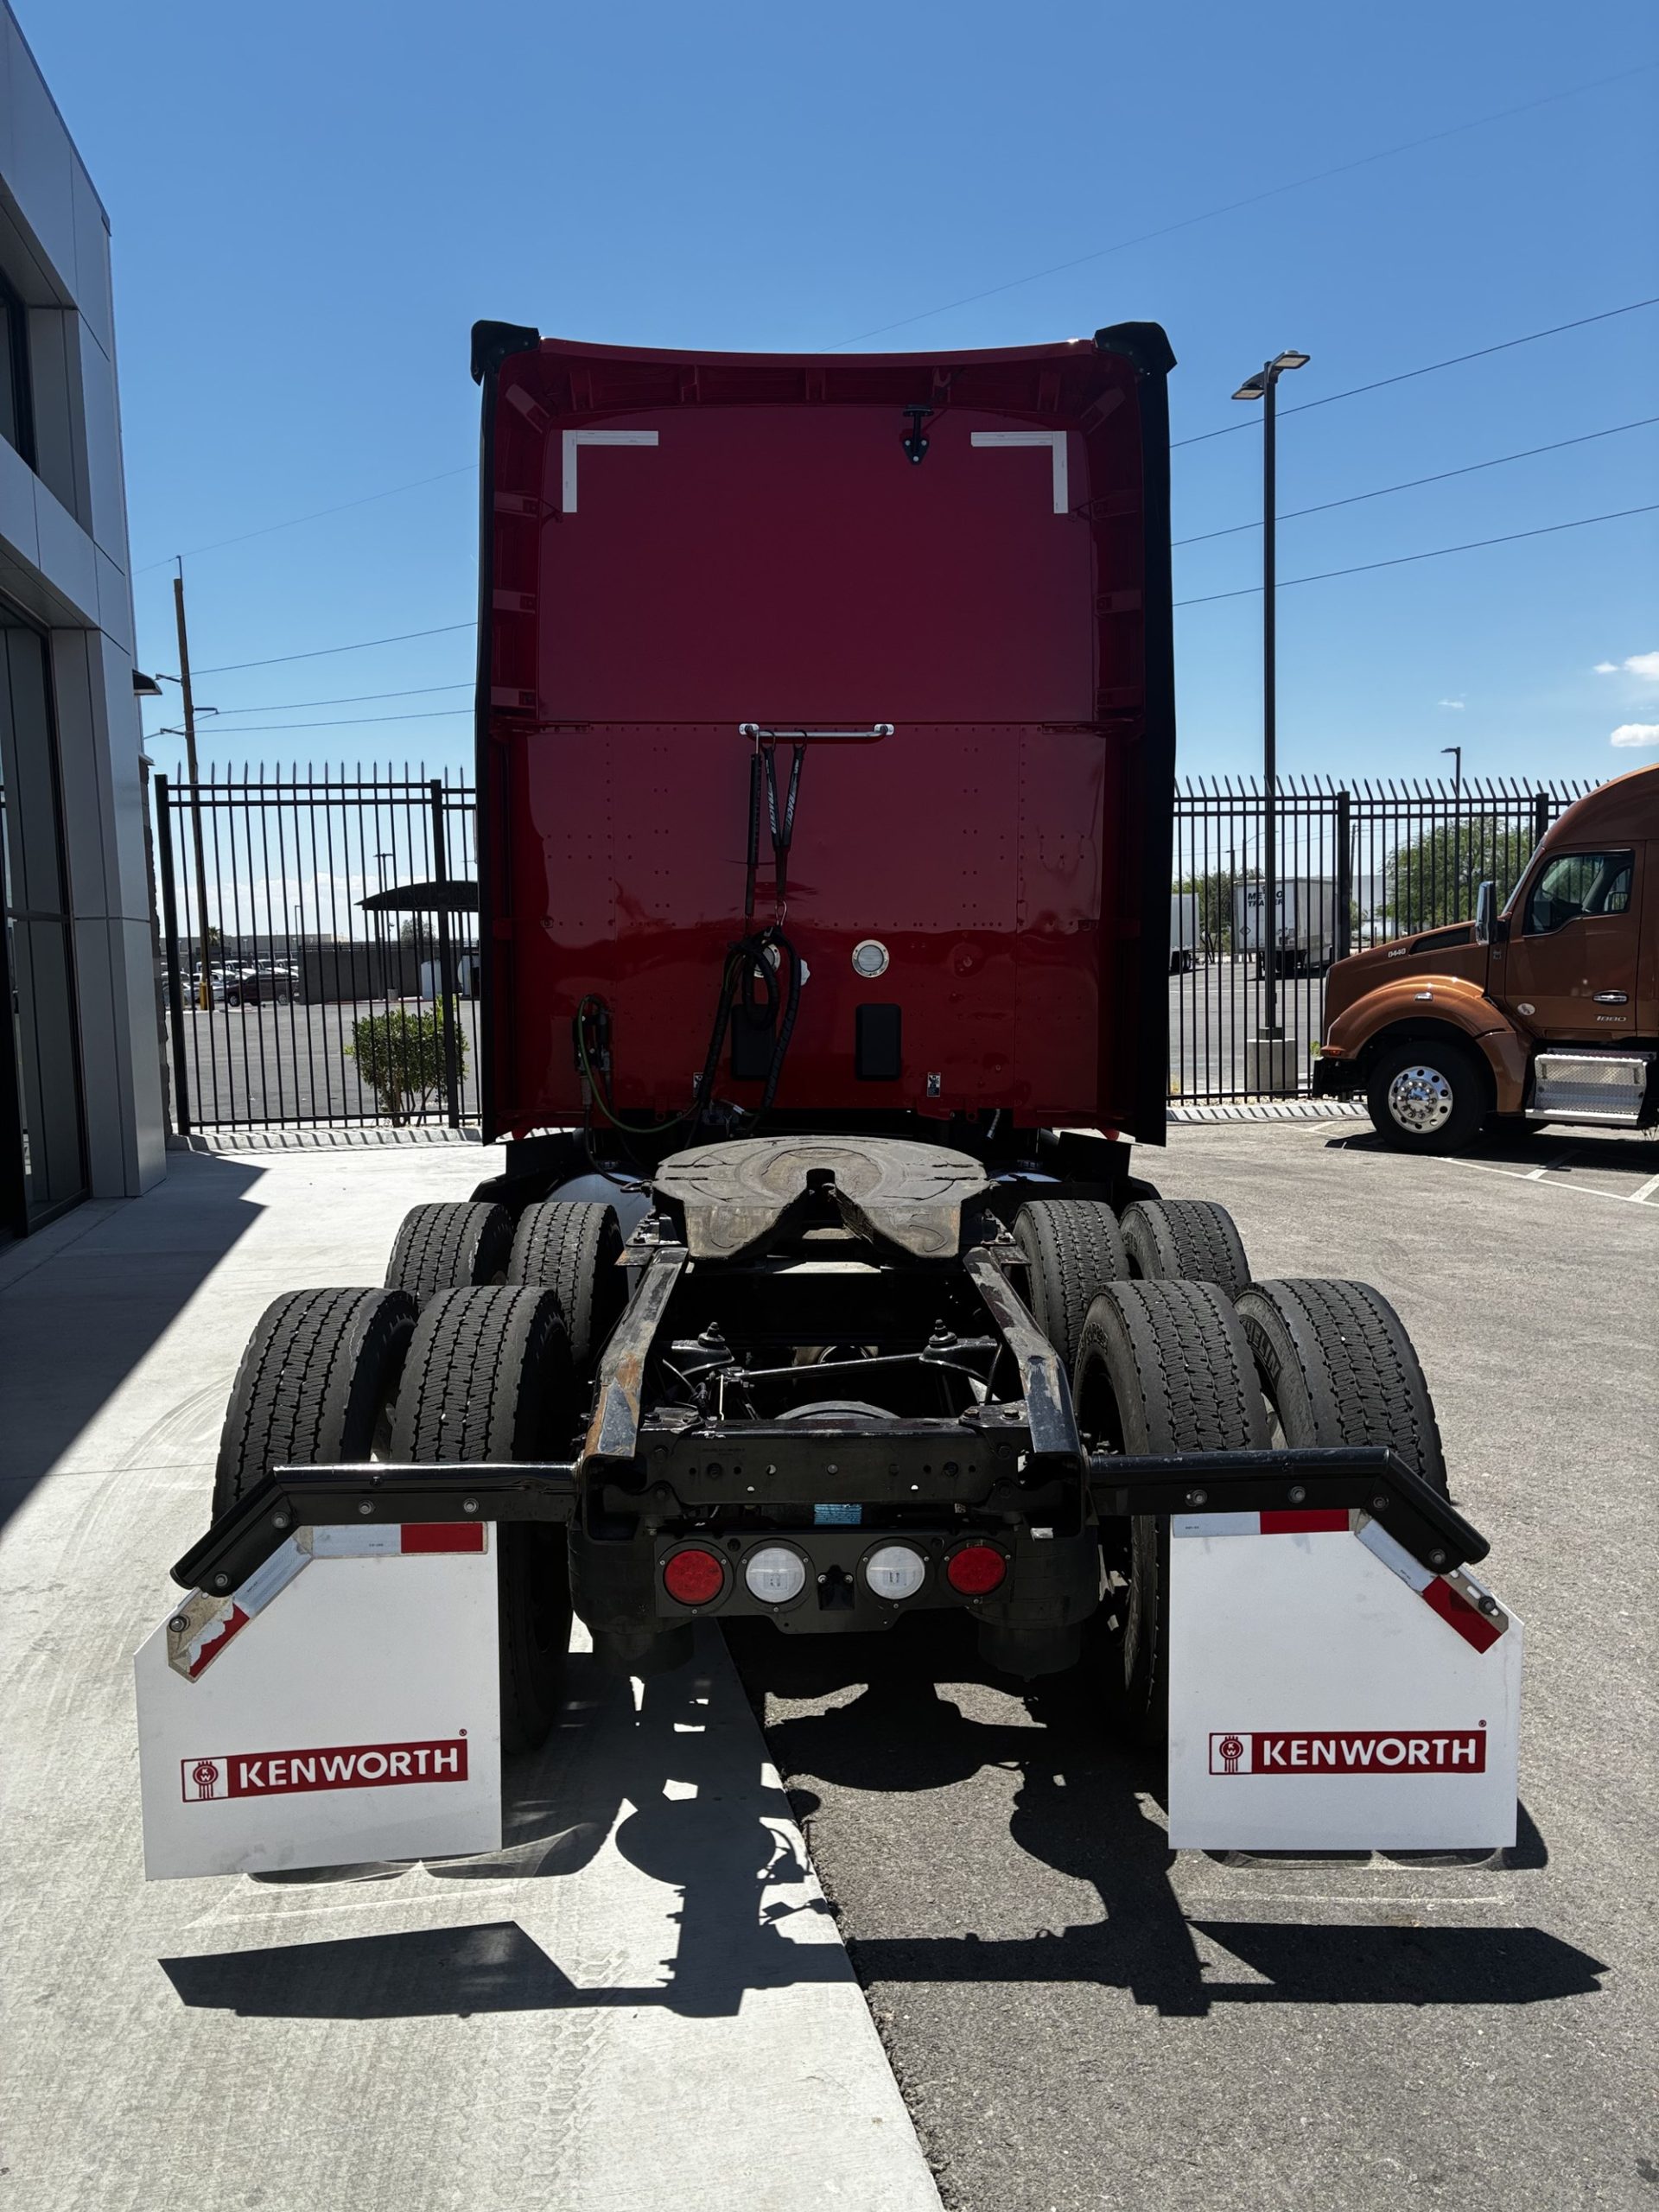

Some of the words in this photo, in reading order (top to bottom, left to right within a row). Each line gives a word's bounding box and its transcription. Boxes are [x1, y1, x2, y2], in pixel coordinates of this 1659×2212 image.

[1248, 891, 1283, 899] MEO
[1263, 1738, 1476, 1766] KENWORTH
[239, 1747, 458, 1789] KENWORTH
